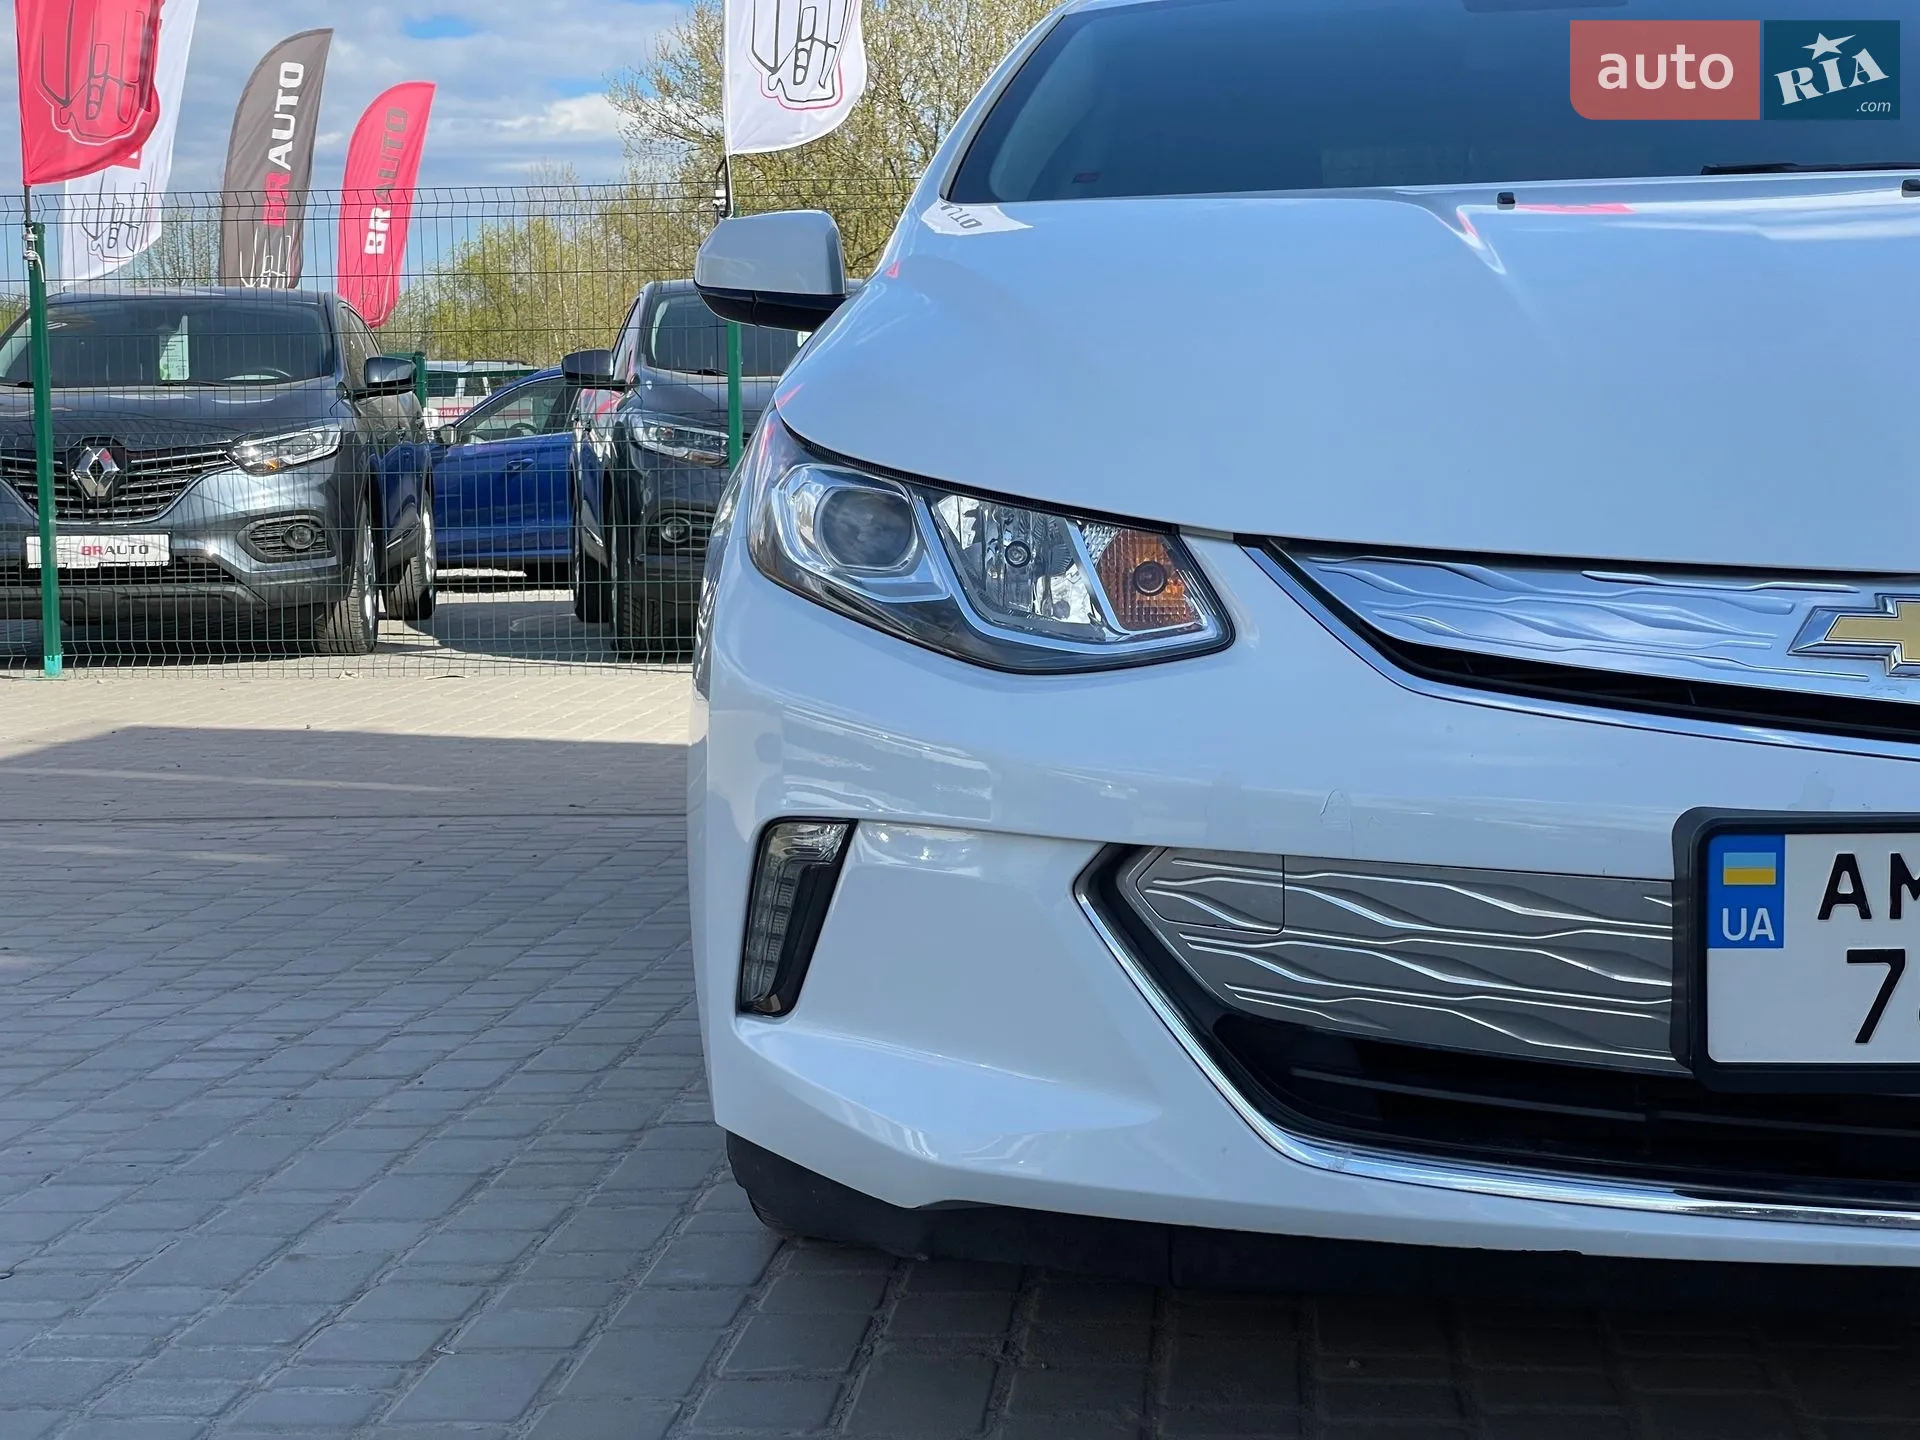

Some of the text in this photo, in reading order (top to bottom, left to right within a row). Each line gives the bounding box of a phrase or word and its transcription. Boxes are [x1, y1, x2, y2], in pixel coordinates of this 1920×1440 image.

[364, 107, 408, 255] BRAUTO
[81, 545, 149, 556] BRAUTO
[1722, 907, 1775, 941] UA
